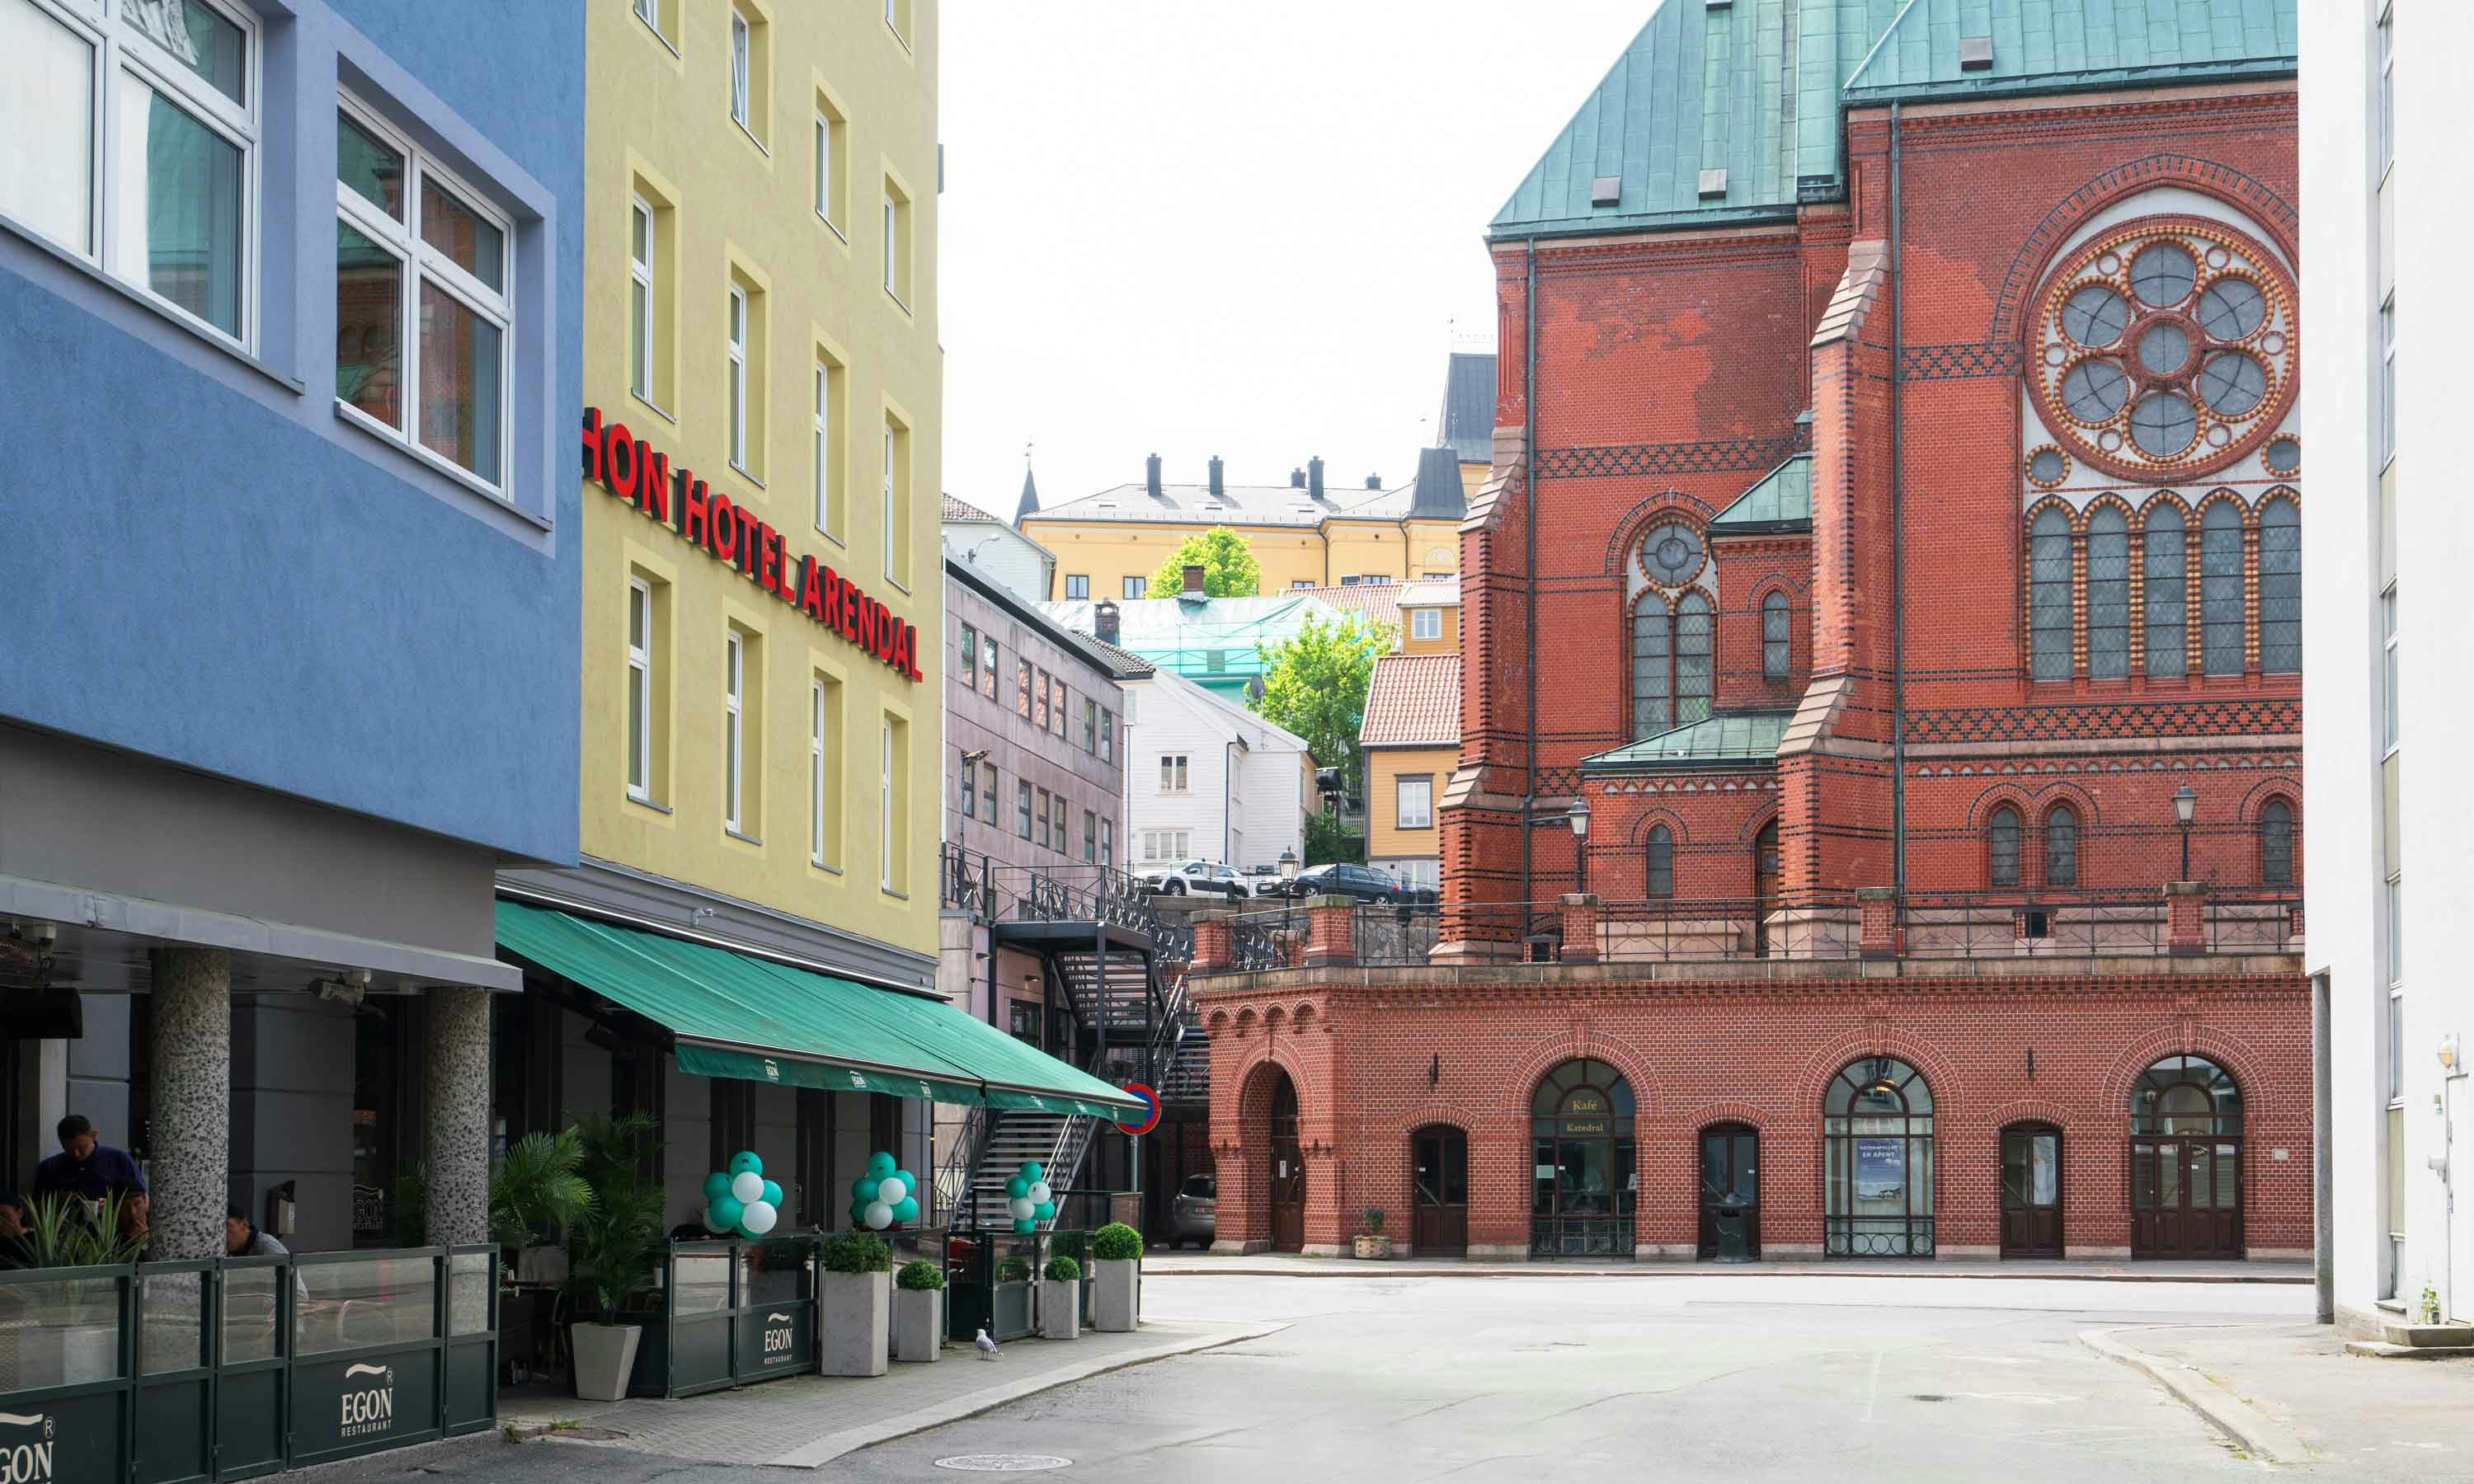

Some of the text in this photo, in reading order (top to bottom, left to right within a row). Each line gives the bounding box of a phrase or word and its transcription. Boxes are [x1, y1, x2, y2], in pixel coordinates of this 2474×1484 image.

[678, 468, 795, 602] HOTEL
[798, 554, 923, 683] ARENDAL
[1573, 1100, 1597, 1111] Kafé
[1567, 1123, 1604, 1132] Katedral
[765, 1328, 793, 1352] EGON
[341, 1388, 393, 1425] EGON
[341, 1420, 392, 1438] RESTAURANT
